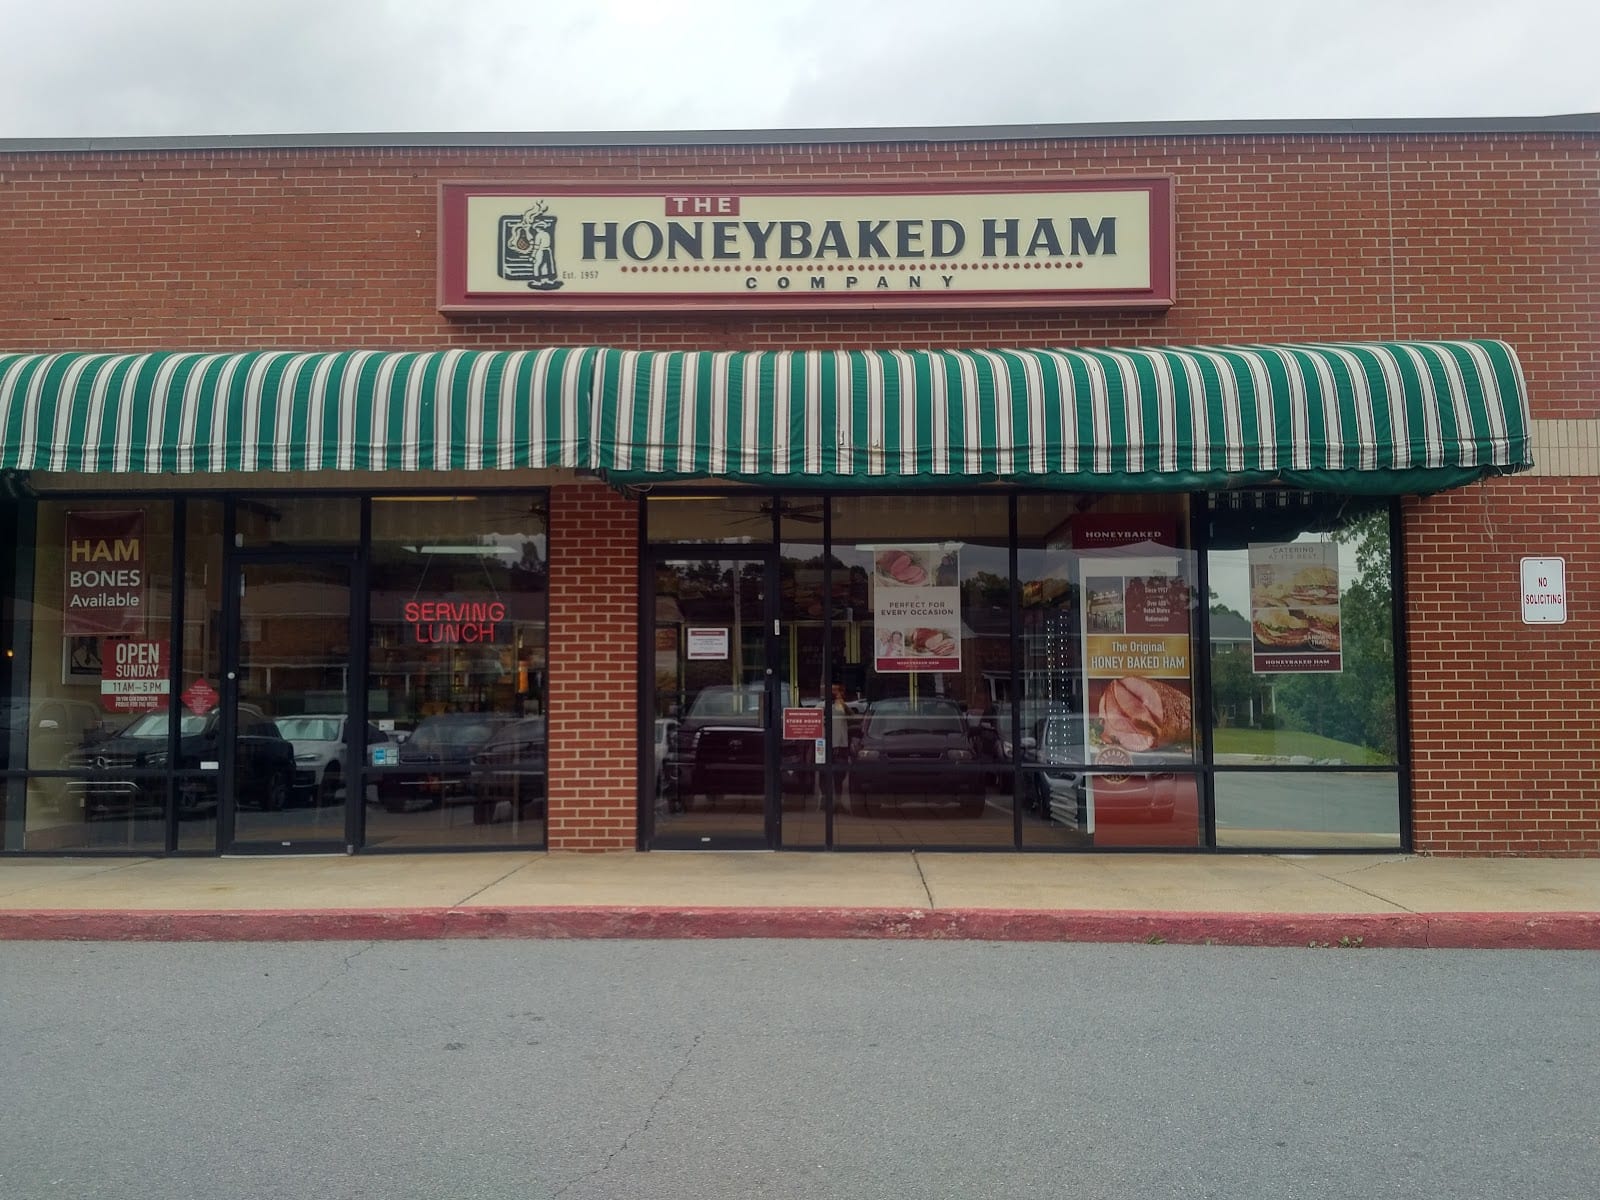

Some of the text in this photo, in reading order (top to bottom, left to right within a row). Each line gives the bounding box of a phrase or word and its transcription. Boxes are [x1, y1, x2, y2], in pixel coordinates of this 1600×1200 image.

[673, 198, 731, 212] THE
[582, 216, 1118, 261] HONEYBAKED HAM
[562, 270, 599, 280] Est. 1957
[745, 275, 954, 290] COMPANY
[71, 539, 139, 562] HAM
[70, 570, 140, 587] BONES
[1538, 577, 1548, 587] NO
[70, 592, 140, 607] Available
[1525, 594, 1562, 604] SOLICITING
[404, 602, 506, 622] SERVING
[415, 623, 495, 643] LUNCH
[115, 643, 160, 664] OPEN
[1111, 641, 1165, 654] The Original
[1091, 656, 1185, 669] HONEY BAKED HAM
[115, 665, 159, 677] SUNDAY
